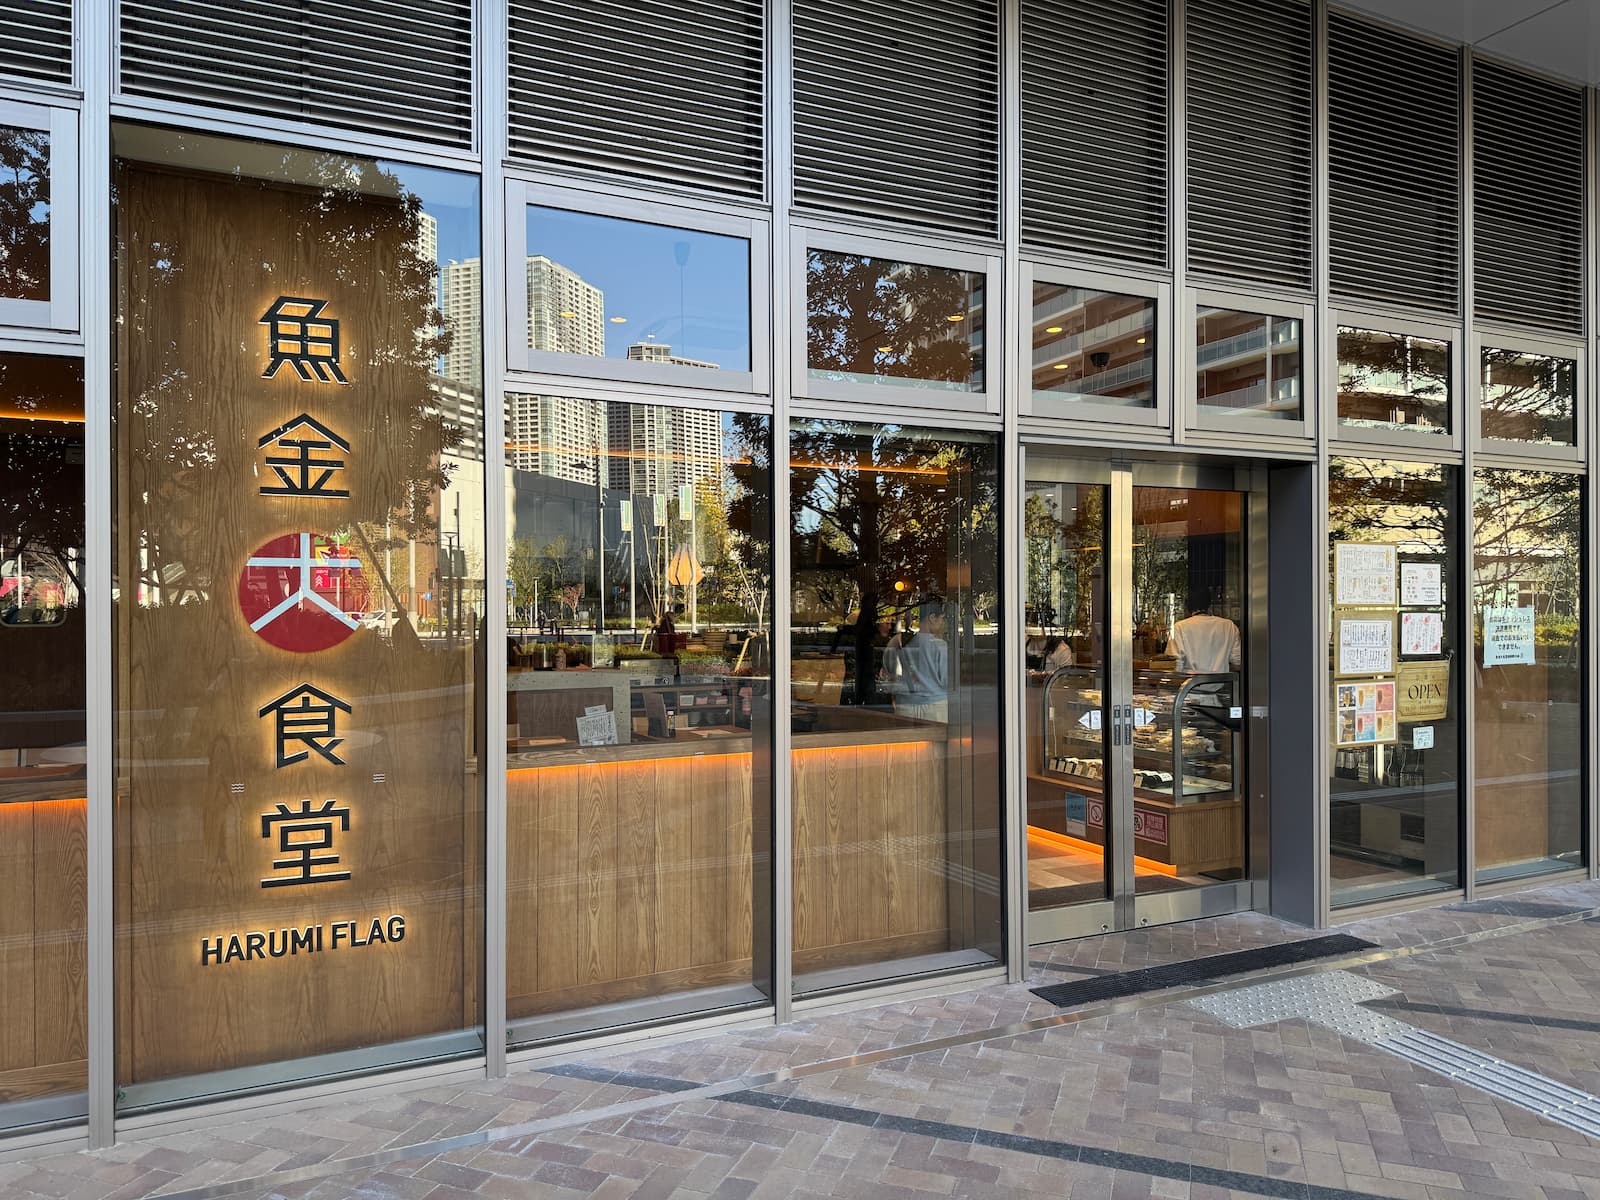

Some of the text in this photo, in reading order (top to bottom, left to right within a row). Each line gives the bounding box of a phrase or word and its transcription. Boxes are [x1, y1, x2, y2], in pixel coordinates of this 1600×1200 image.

[258, 296, 352, 889] 魚金 食堂
[1408, 684, 1442, 700] OPEN
[202, 915, 405, 966] HARUMI FLAG
